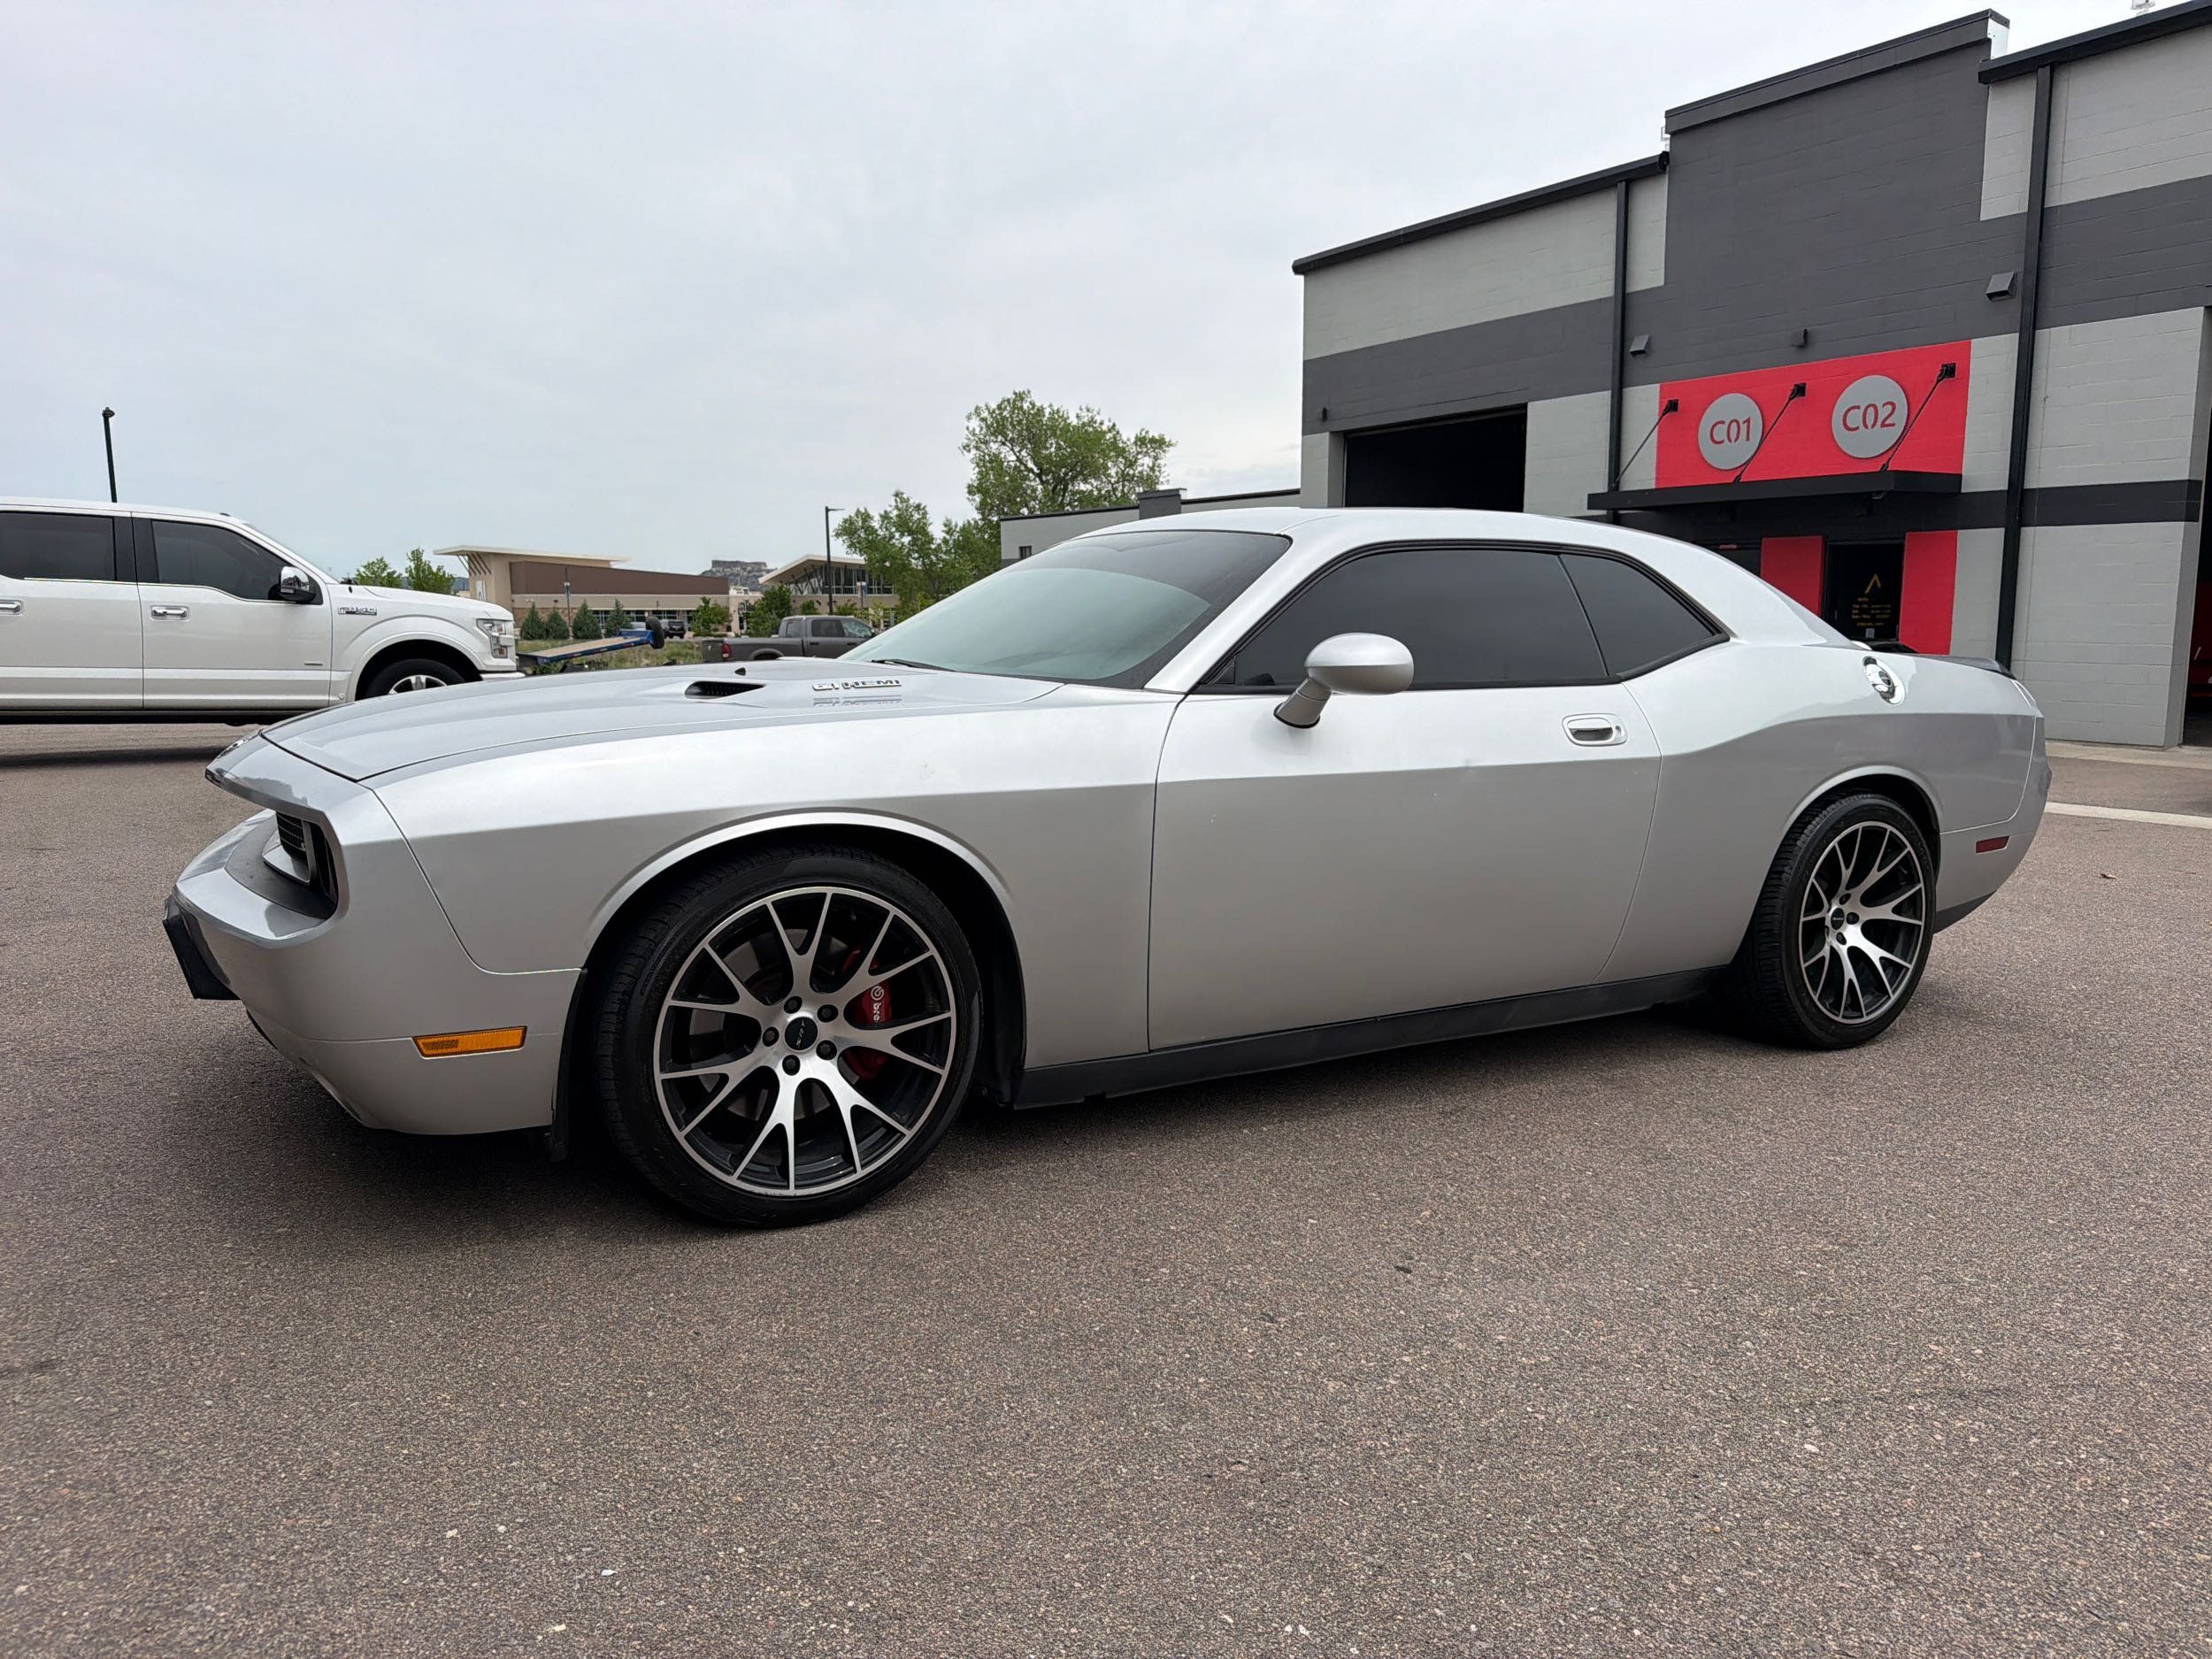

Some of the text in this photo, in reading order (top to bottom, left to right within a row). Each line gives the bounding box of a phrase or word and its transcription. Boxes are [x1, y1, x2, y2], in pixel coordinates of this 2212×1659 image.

[1841, 401, 1897, 432] C02
[1709, 417, 1752, 444] C01
[872, 1002, 881, 1022] bre
